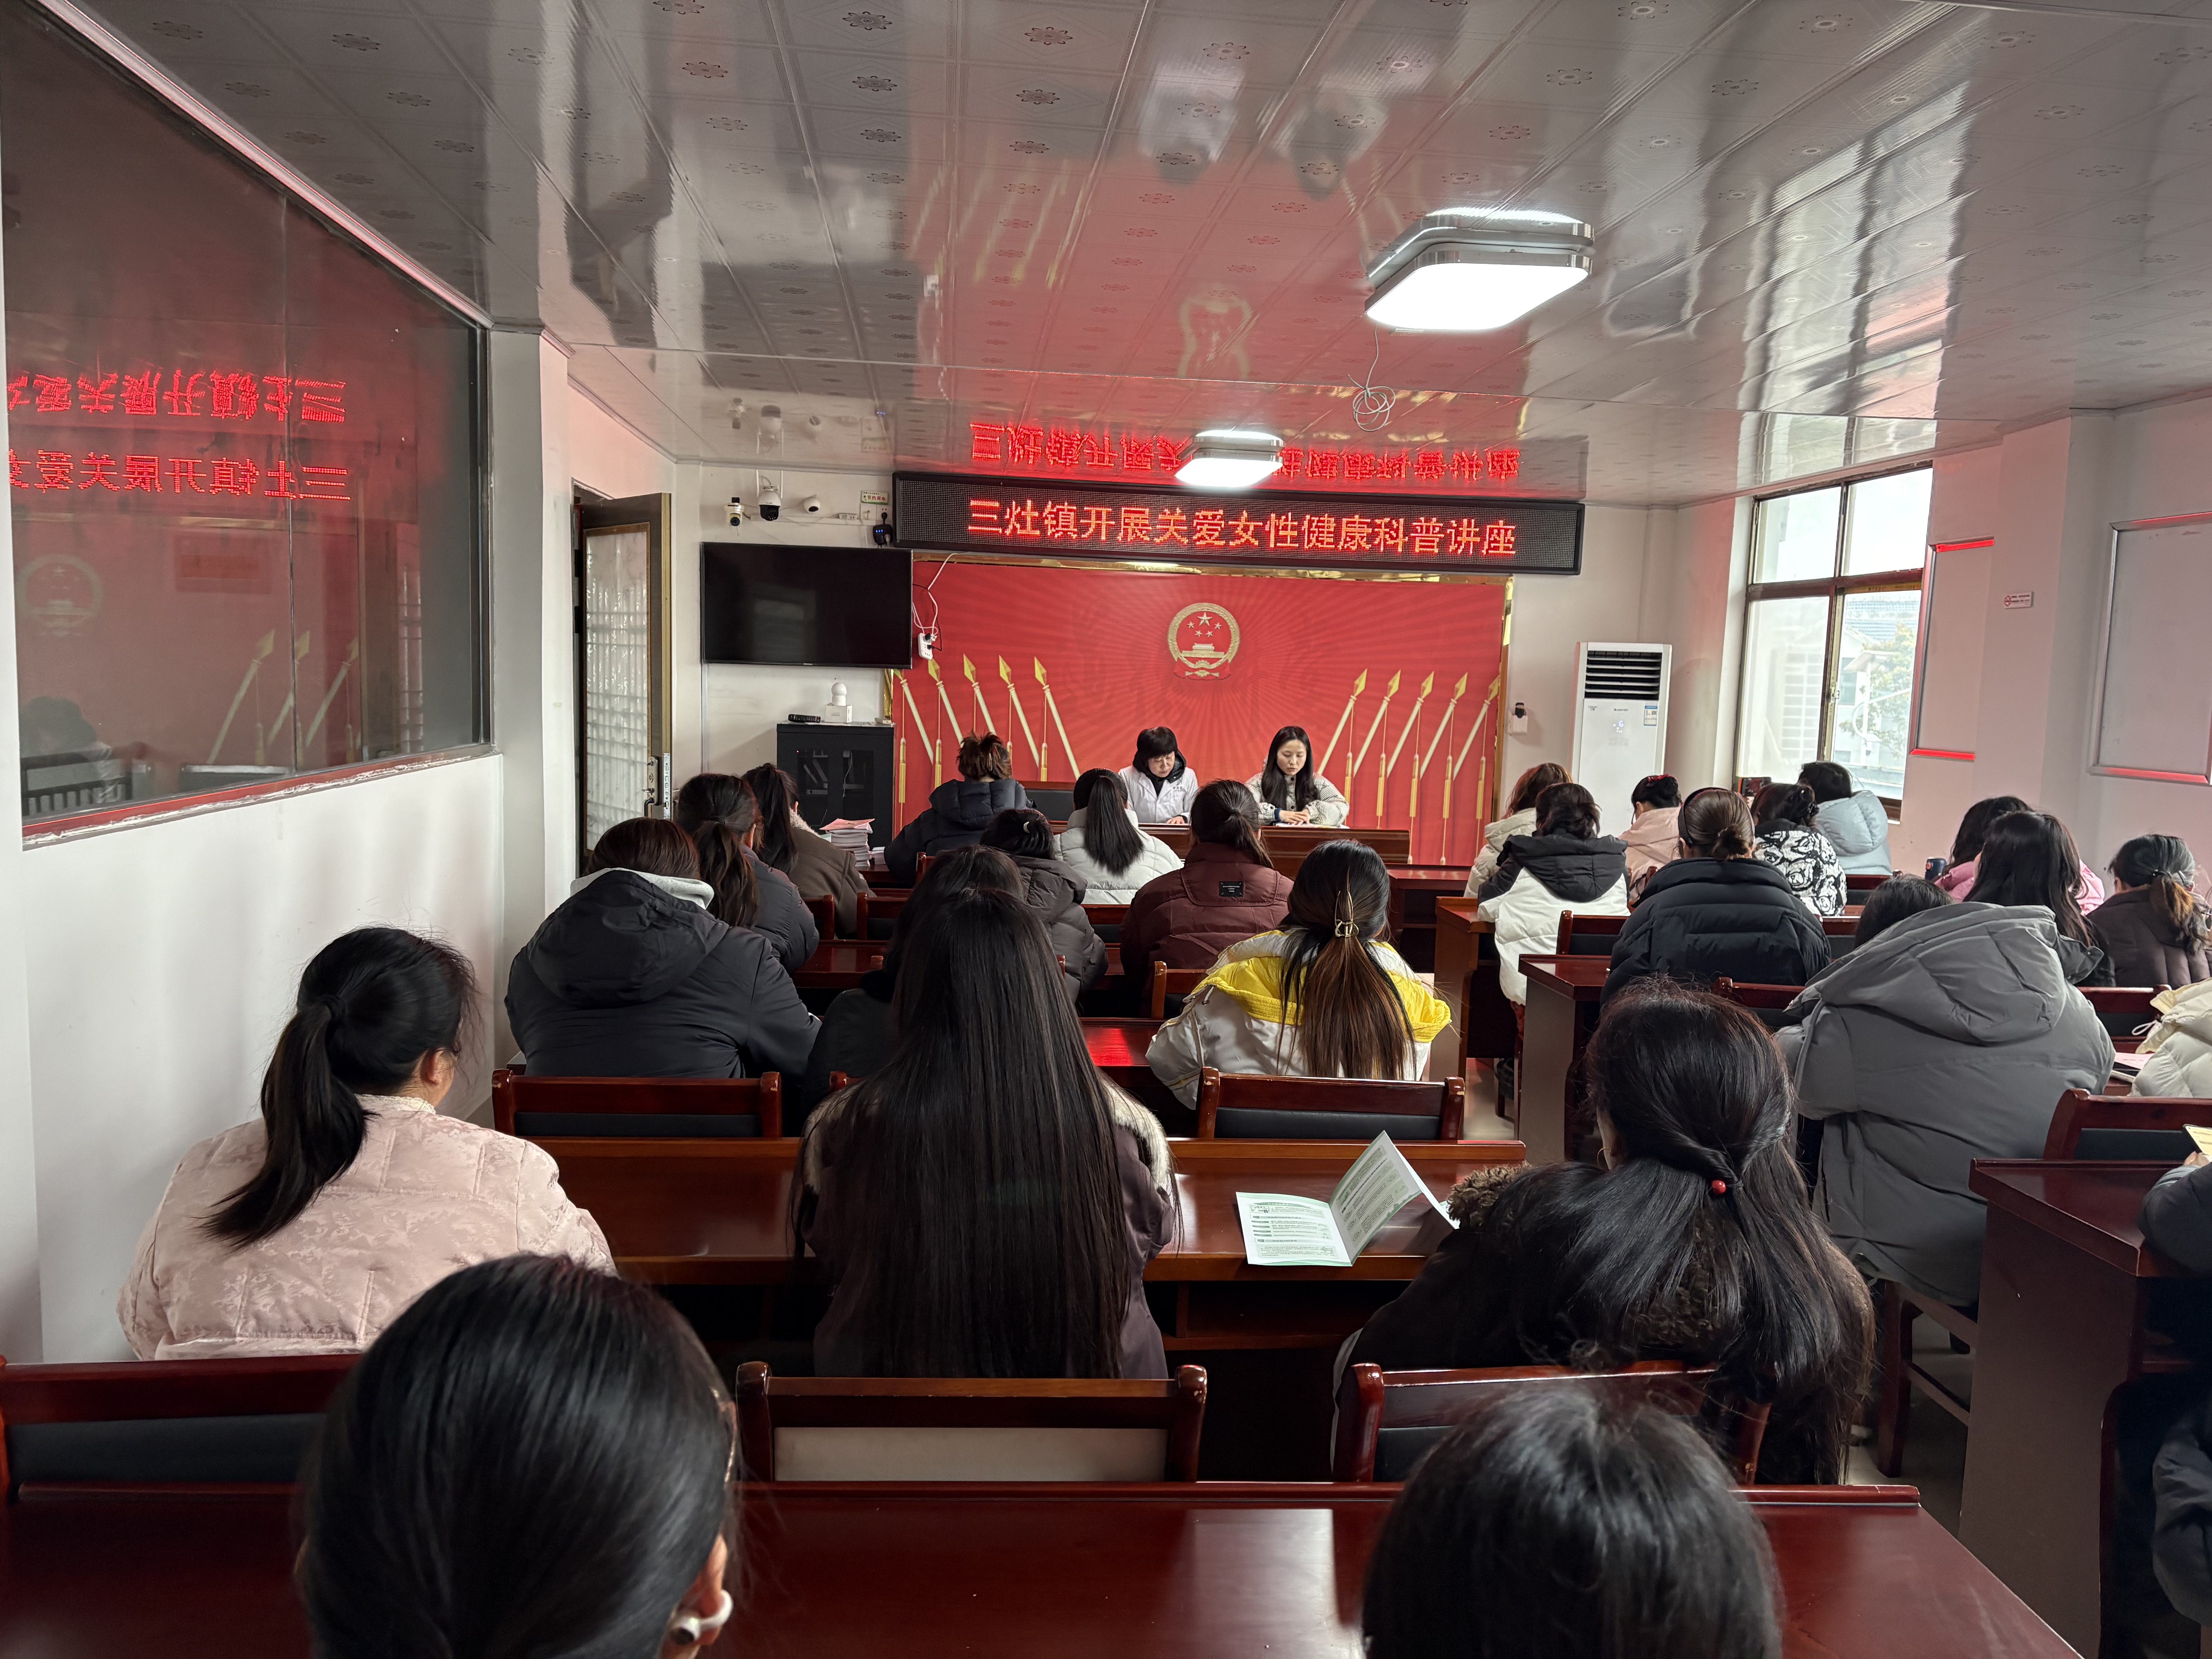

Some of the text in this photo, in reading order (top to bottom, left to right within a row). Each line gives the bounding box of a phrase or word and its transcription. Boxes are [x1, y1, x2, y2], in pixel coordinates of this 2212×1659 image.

[968, 498, 1517, 555] 三灶镇开展关爱女性健康科普讲座
